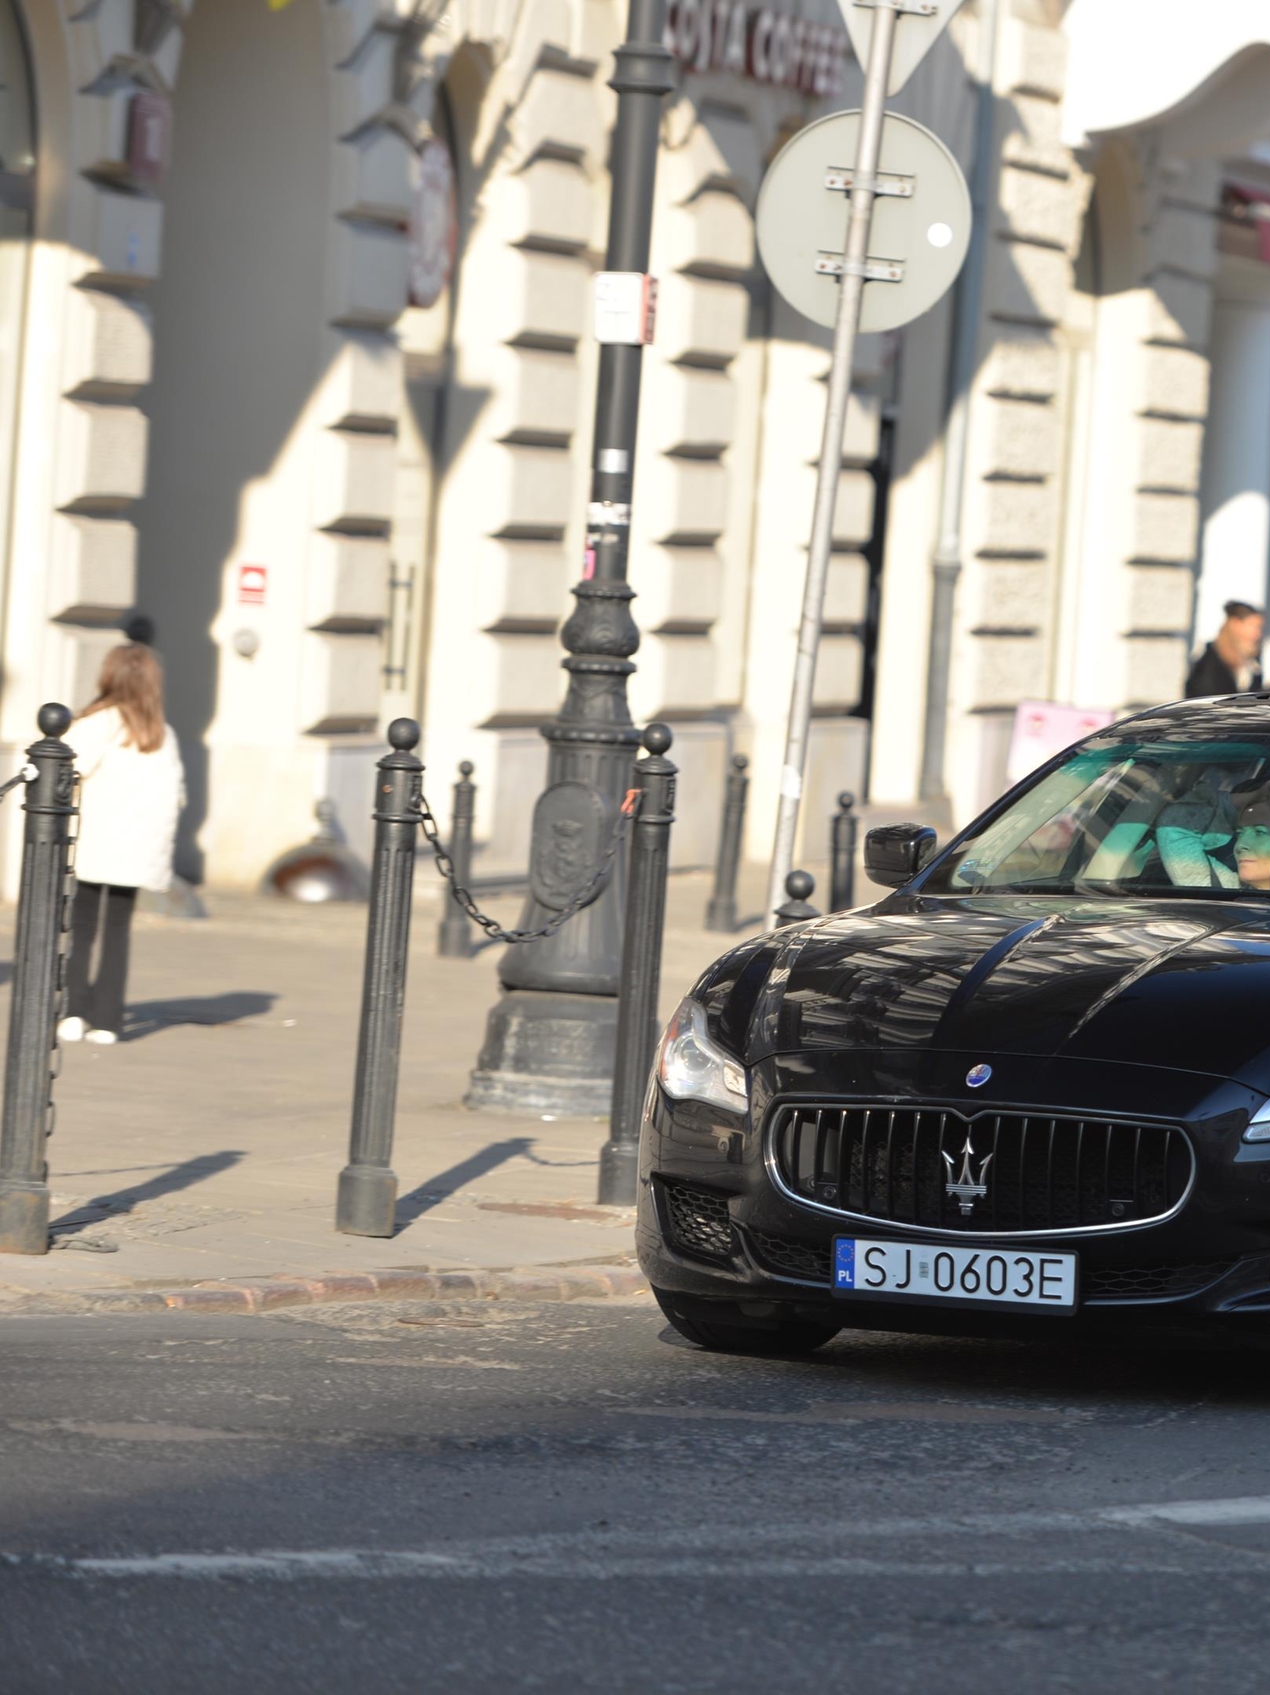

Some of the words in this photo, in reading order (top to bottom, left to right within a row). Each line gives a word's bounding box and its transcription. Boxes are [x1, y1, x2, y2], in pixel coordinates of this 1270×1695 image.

[838, 1270, 852, 1282] PL
[864, 1246, 911, 1289] SJ
[934, 1251, 1063, 1300] 0603E
